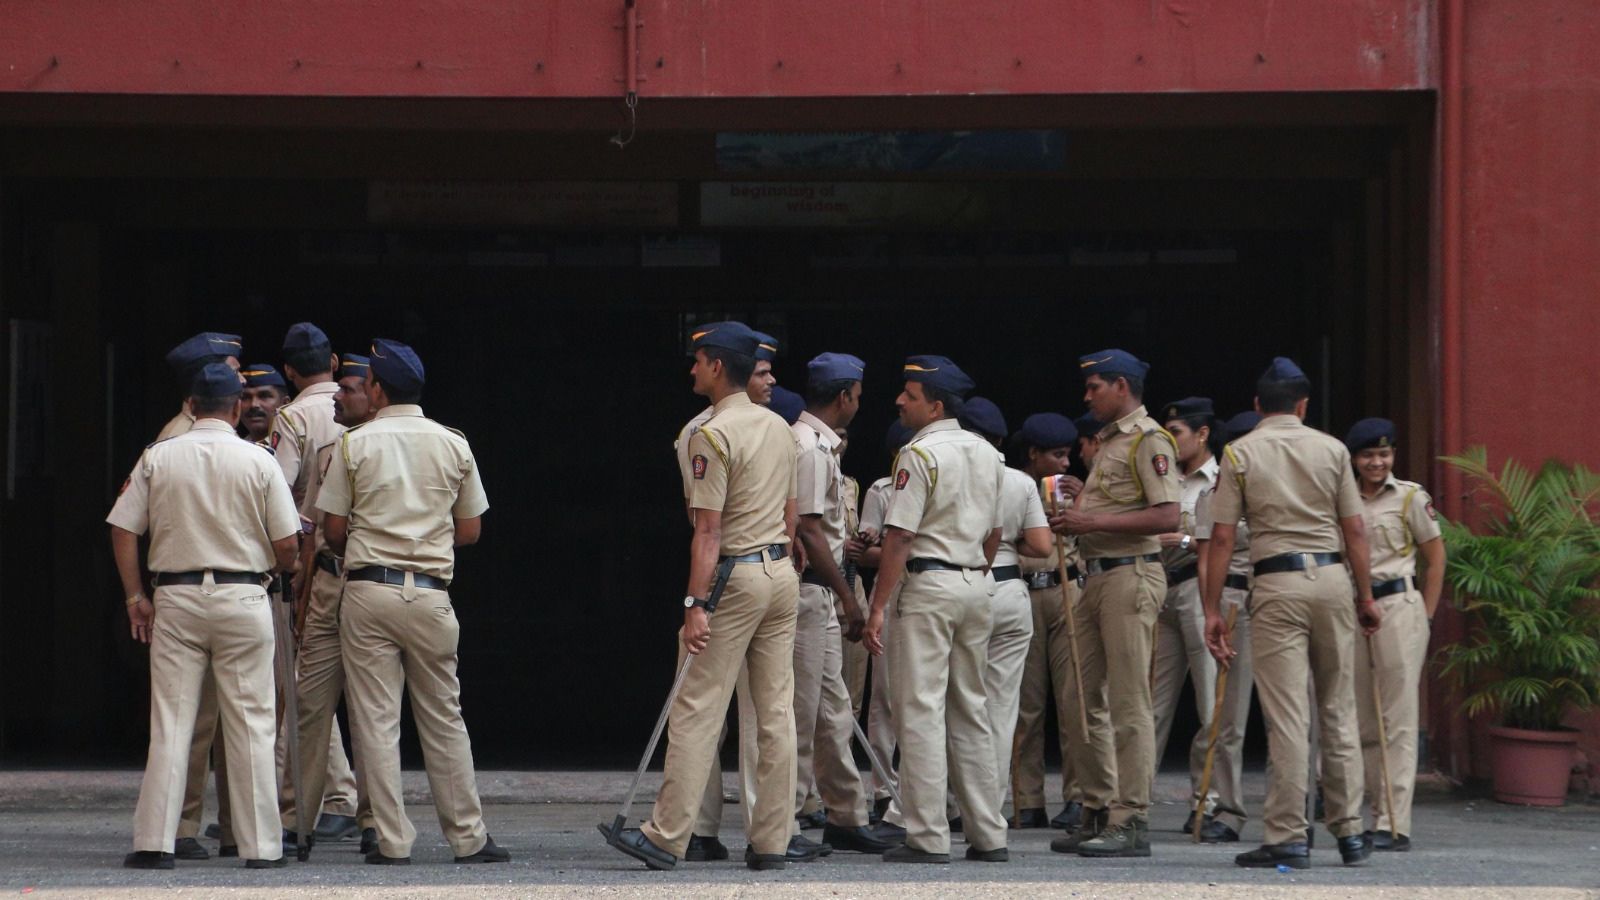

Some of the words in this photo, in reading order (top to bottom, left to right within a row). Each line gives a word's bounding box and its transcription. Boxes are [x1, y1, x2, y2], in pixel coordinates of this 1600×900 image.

[730, 183, 815, 199] beginning
[819, 184, 835, 197] of
[786, 199, 849, 213] wisdom
